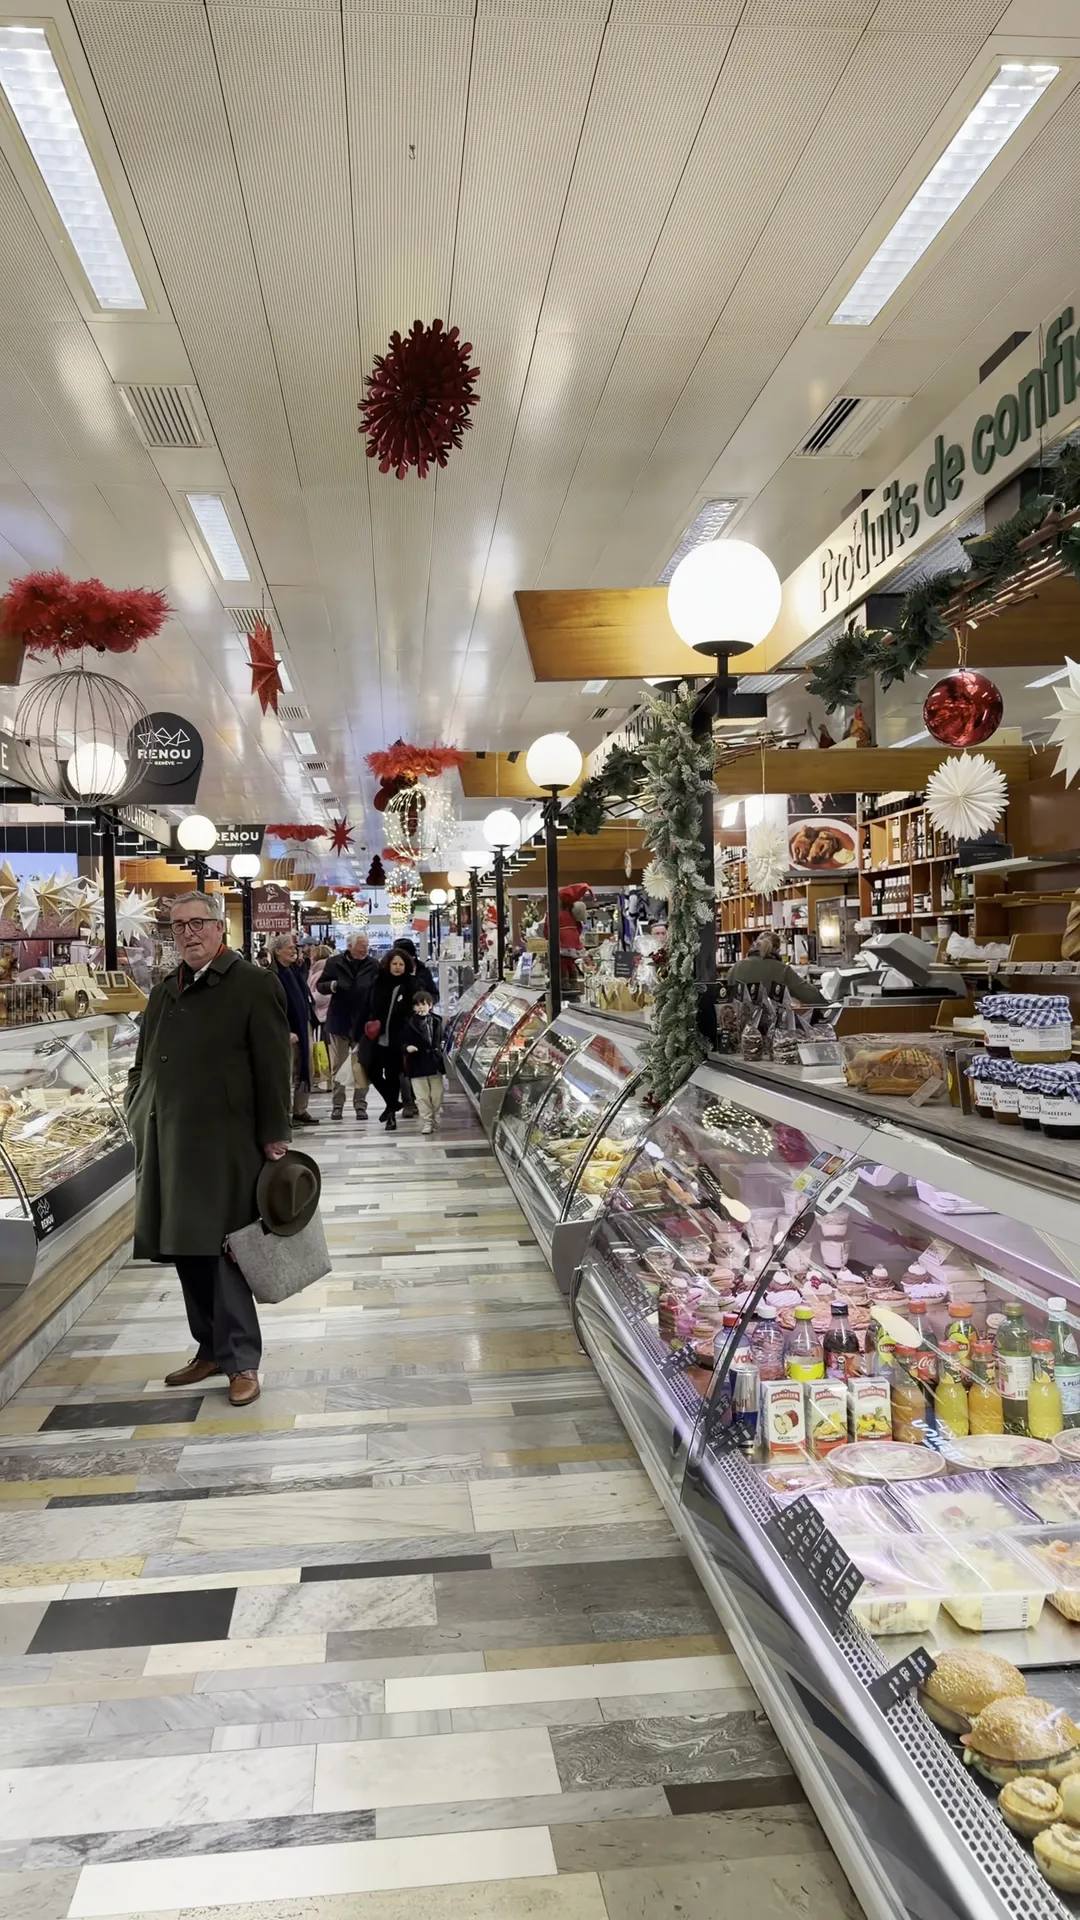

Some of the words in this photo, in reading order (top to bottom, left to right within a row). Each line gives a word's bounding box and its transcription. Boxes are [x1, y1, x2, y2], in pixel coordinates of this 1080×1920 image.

[819, 479, 919, 613] Produits
[924, 435, 965, 518] de
[137, 749, 191, 760] RENOU
[258, 902, 286, 913] BOUCHERIE
[255, 918, 290, 929] CHARCUTERIE
[772, 1392, 799, 1400] RAMSEIER
